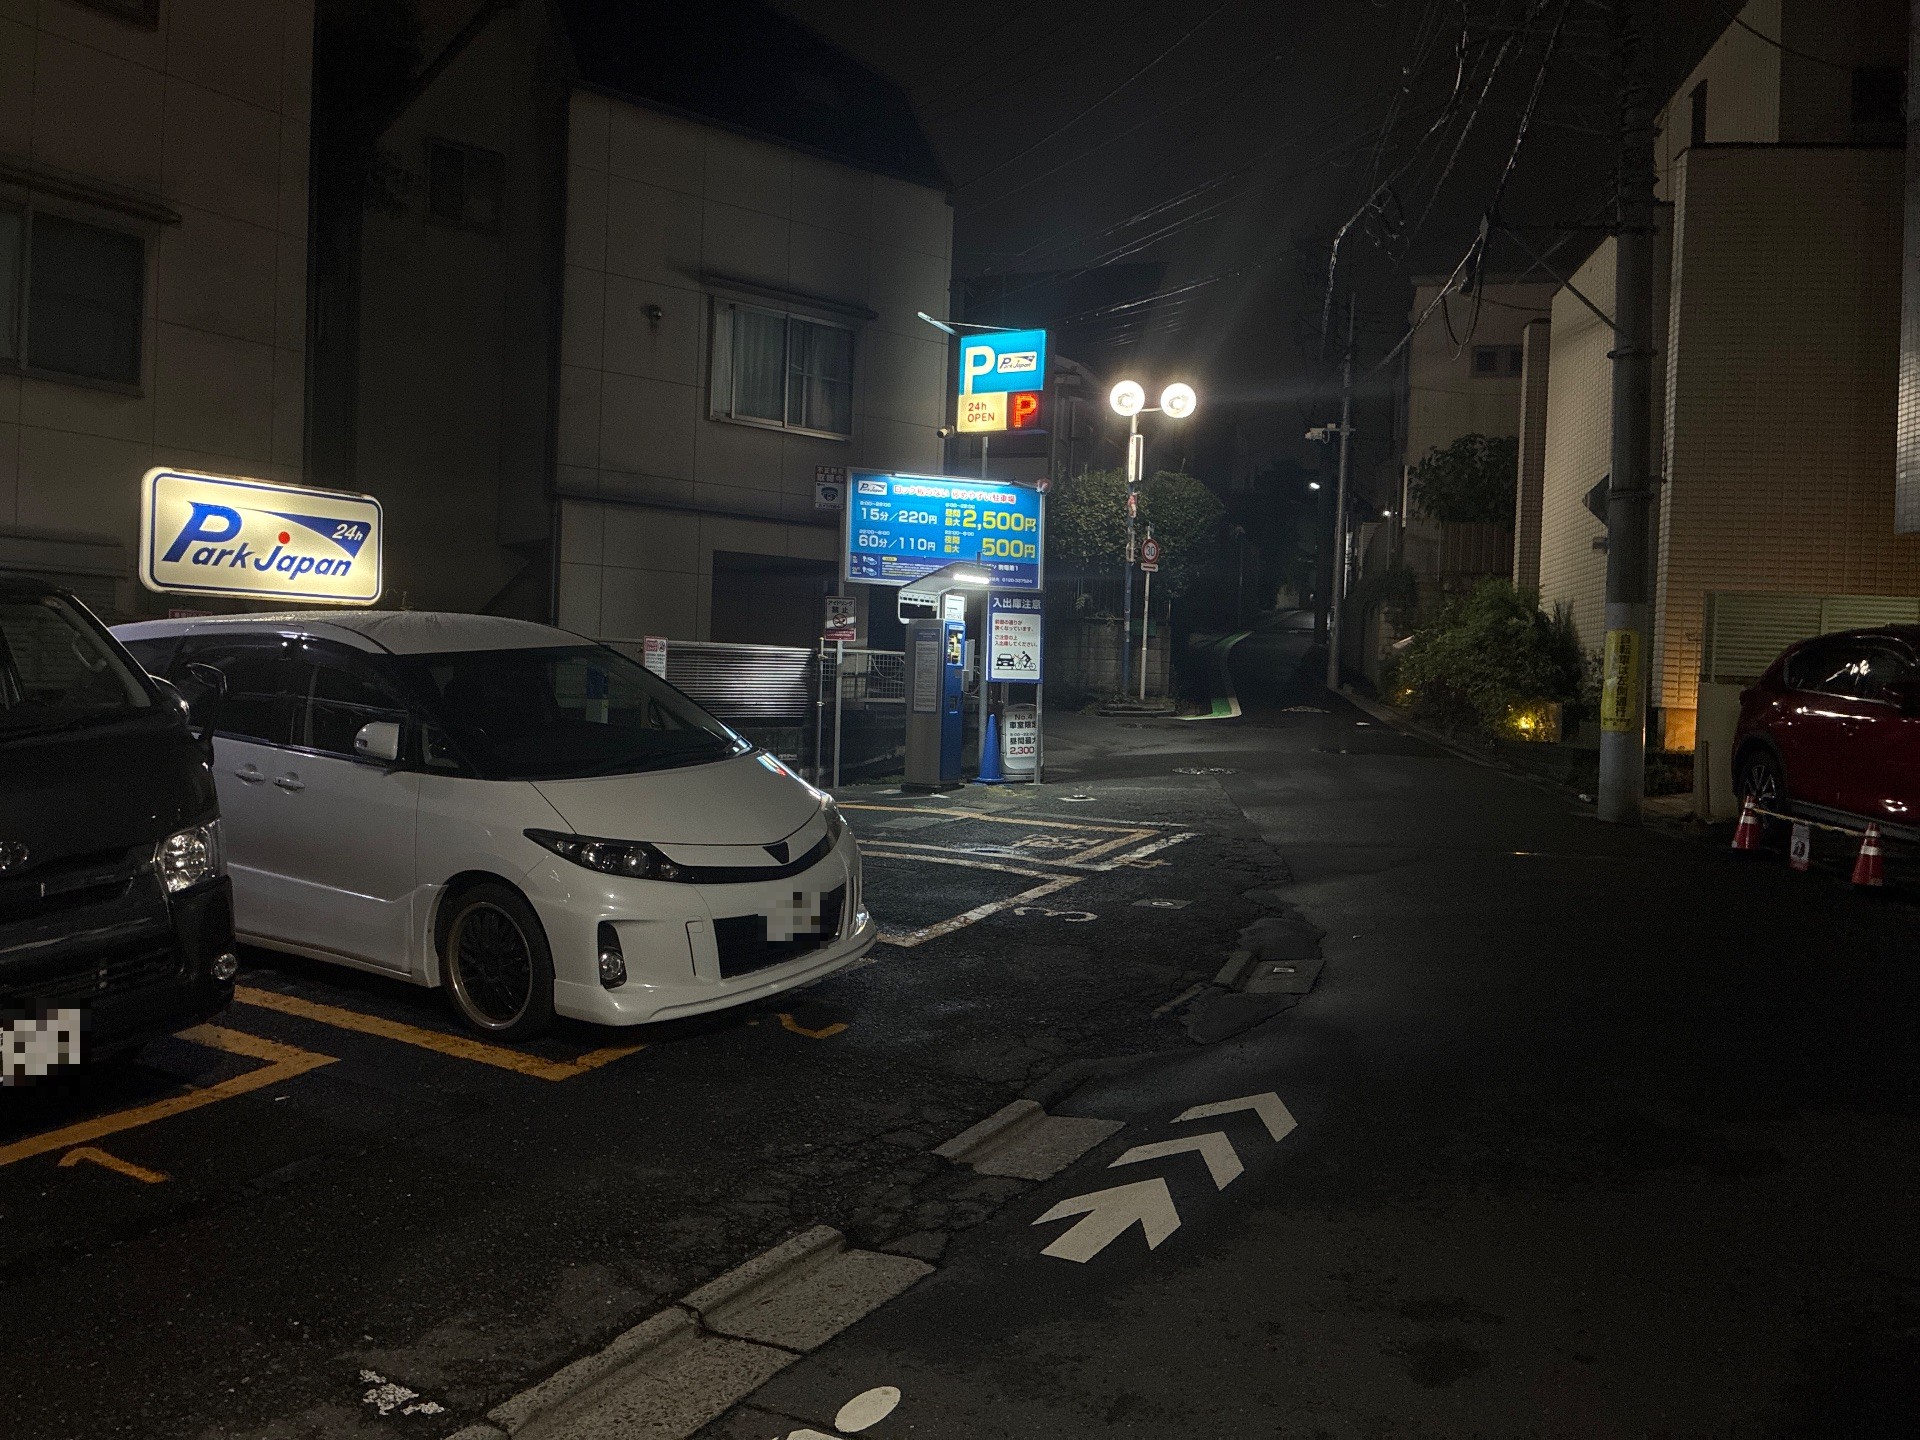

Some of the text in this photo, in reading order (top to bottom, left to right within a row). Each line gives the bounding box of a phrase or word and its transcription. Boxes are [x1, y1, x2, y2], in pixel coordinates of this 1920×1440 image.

[1000, 357, 1013, 369] Park
[968, 402, 986, 412] 24h
[1014, 395, 1037, 428] P
[968, 412, 994, 422] OPEN
[962, 510, 1036, 532] 2,500円
[162, 501, 352, 580] Park Japan
[332, 524, 364, 542] 24h
[982, 538, 1036, 558] 500円
[1146, 546, 1155, 556] 30
[993, 597, 1041, 610] 入出庫注意
[1616, 634, 1631, 717] 自転車は左側通行
[1010, 746, 1034, 754] 2,300
